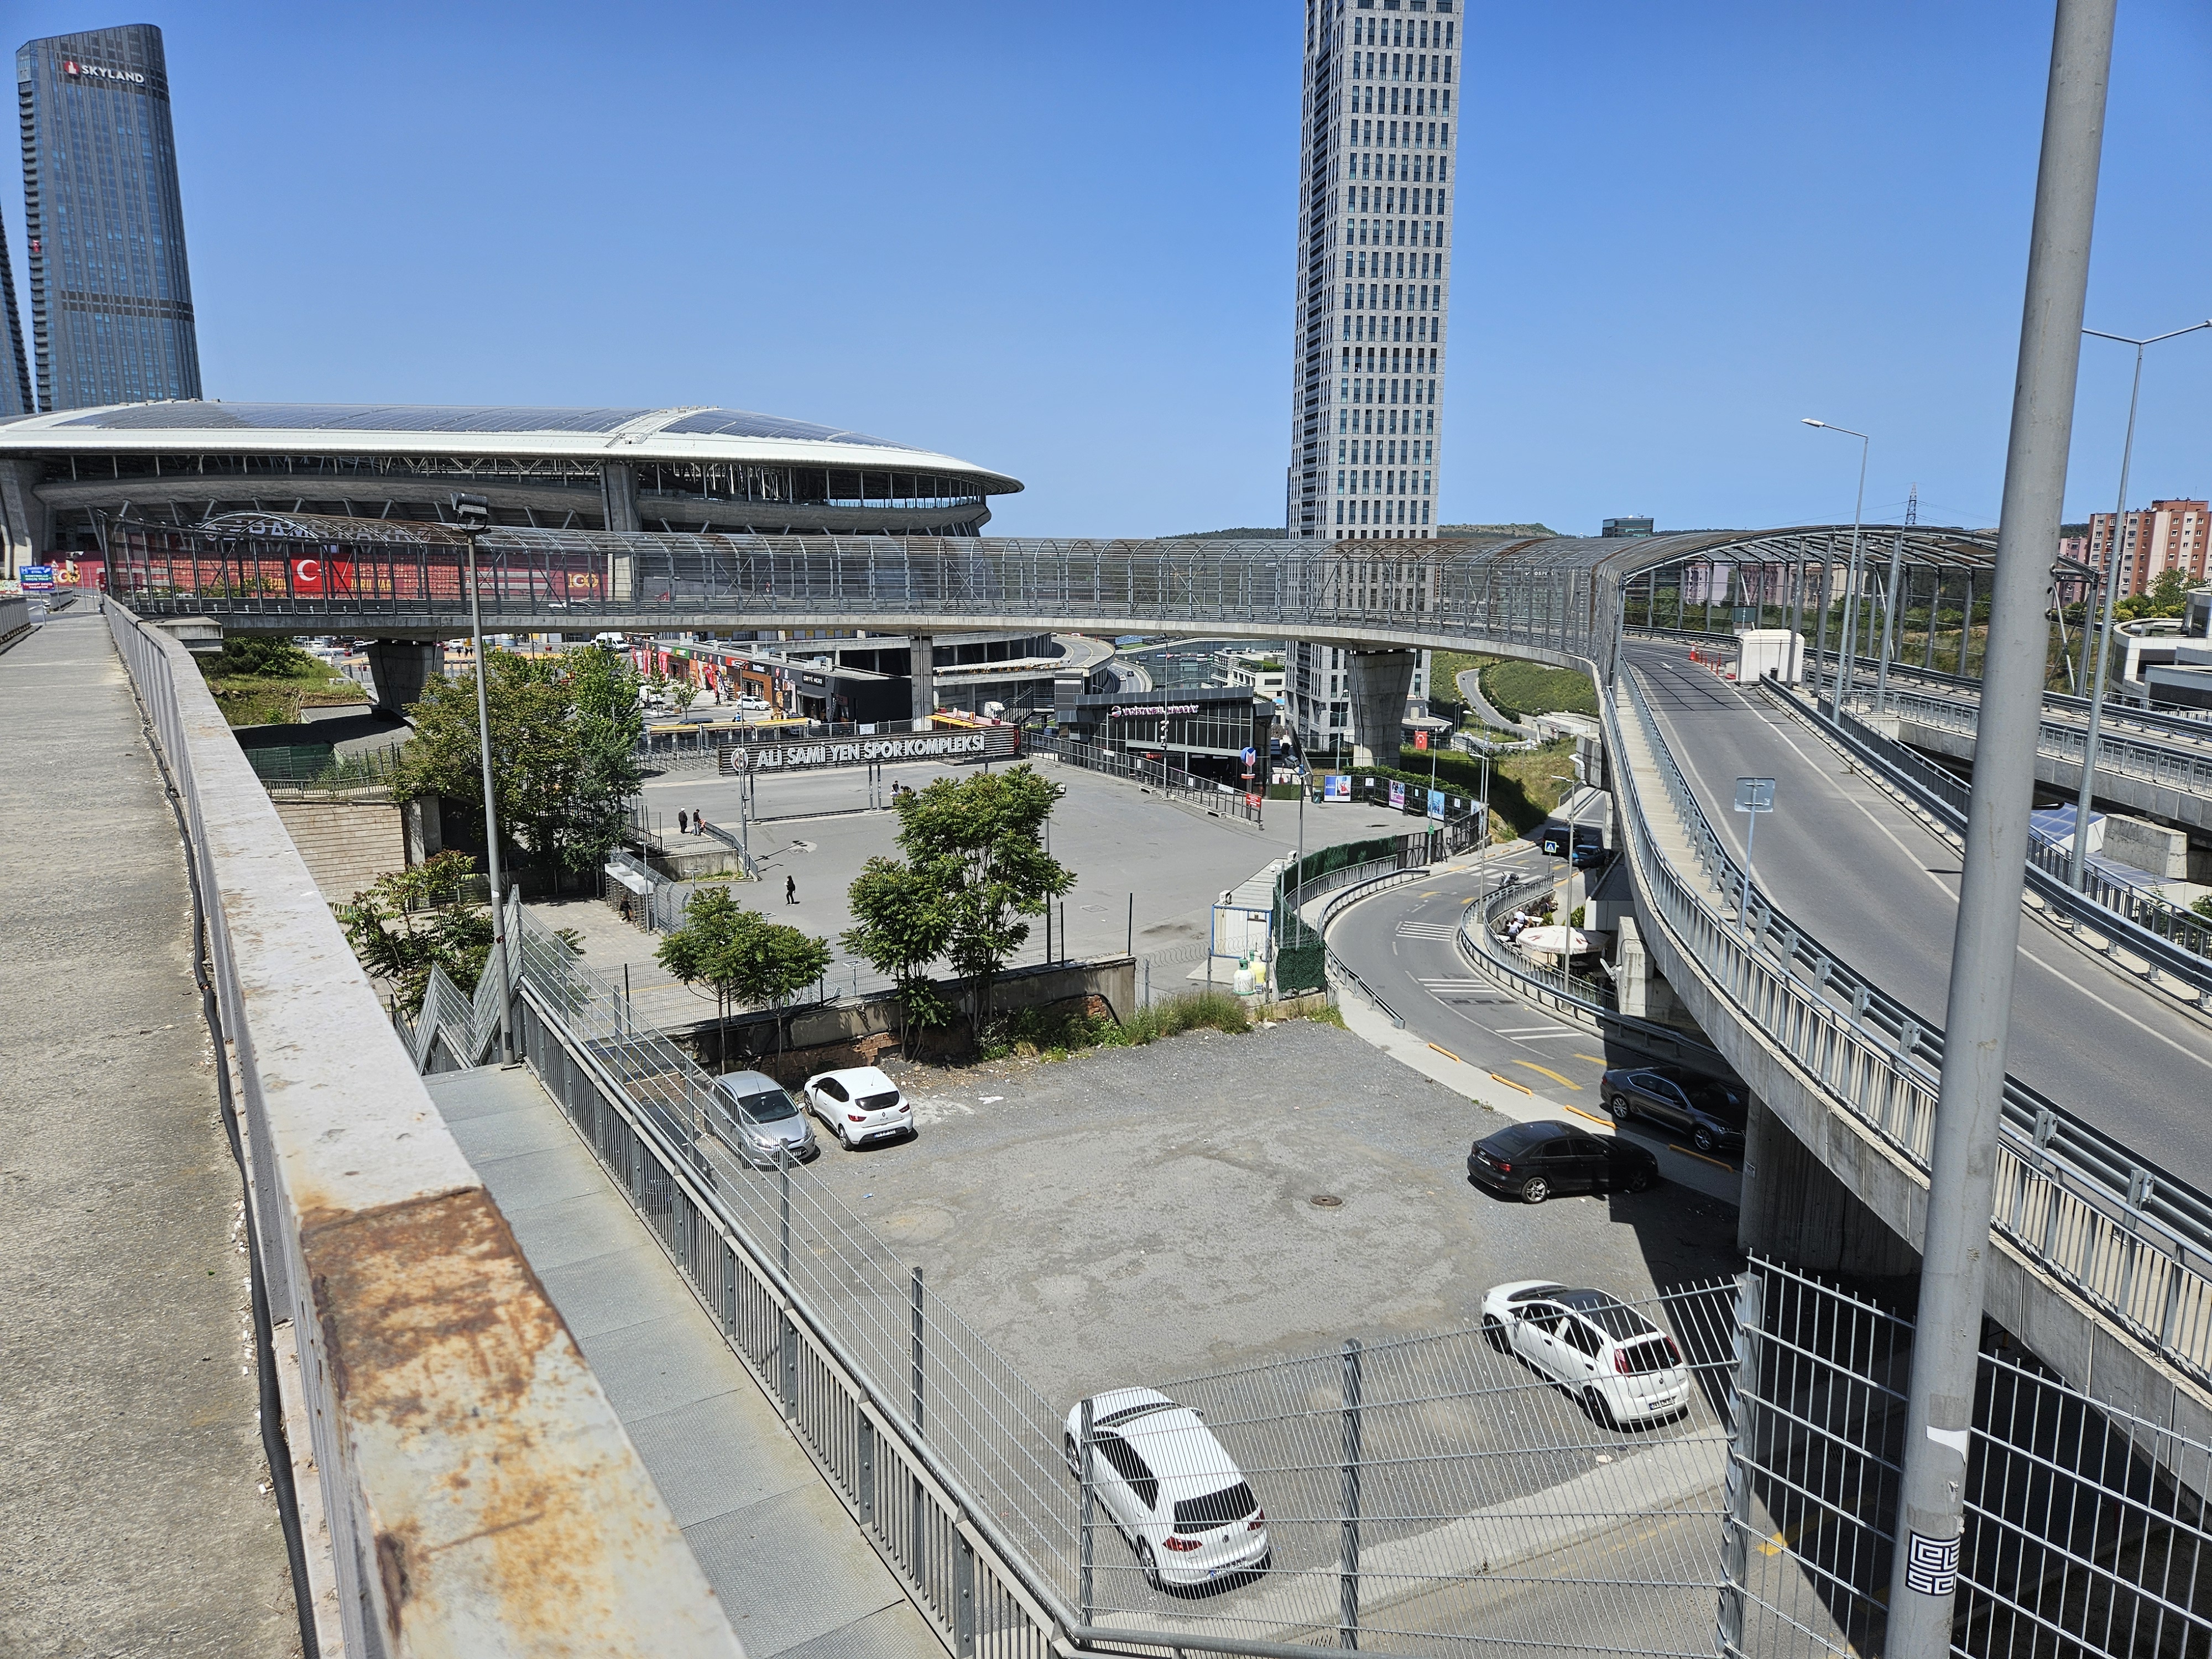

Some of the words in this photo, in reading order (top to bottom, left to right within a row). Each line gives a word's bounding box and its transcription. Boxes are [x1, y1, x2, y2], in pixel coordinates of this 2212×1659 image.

[81, 65, 144, 83] SKYLAND
[1167, 705, 1199, 714] HAVARAY
[757, 744, 782, 768] ALİ
[787, 742, 826, 765] SAMİ
[830, 744, 860, 761] YEN
[905, 731, 985, 757] KOMPLEKSİ
